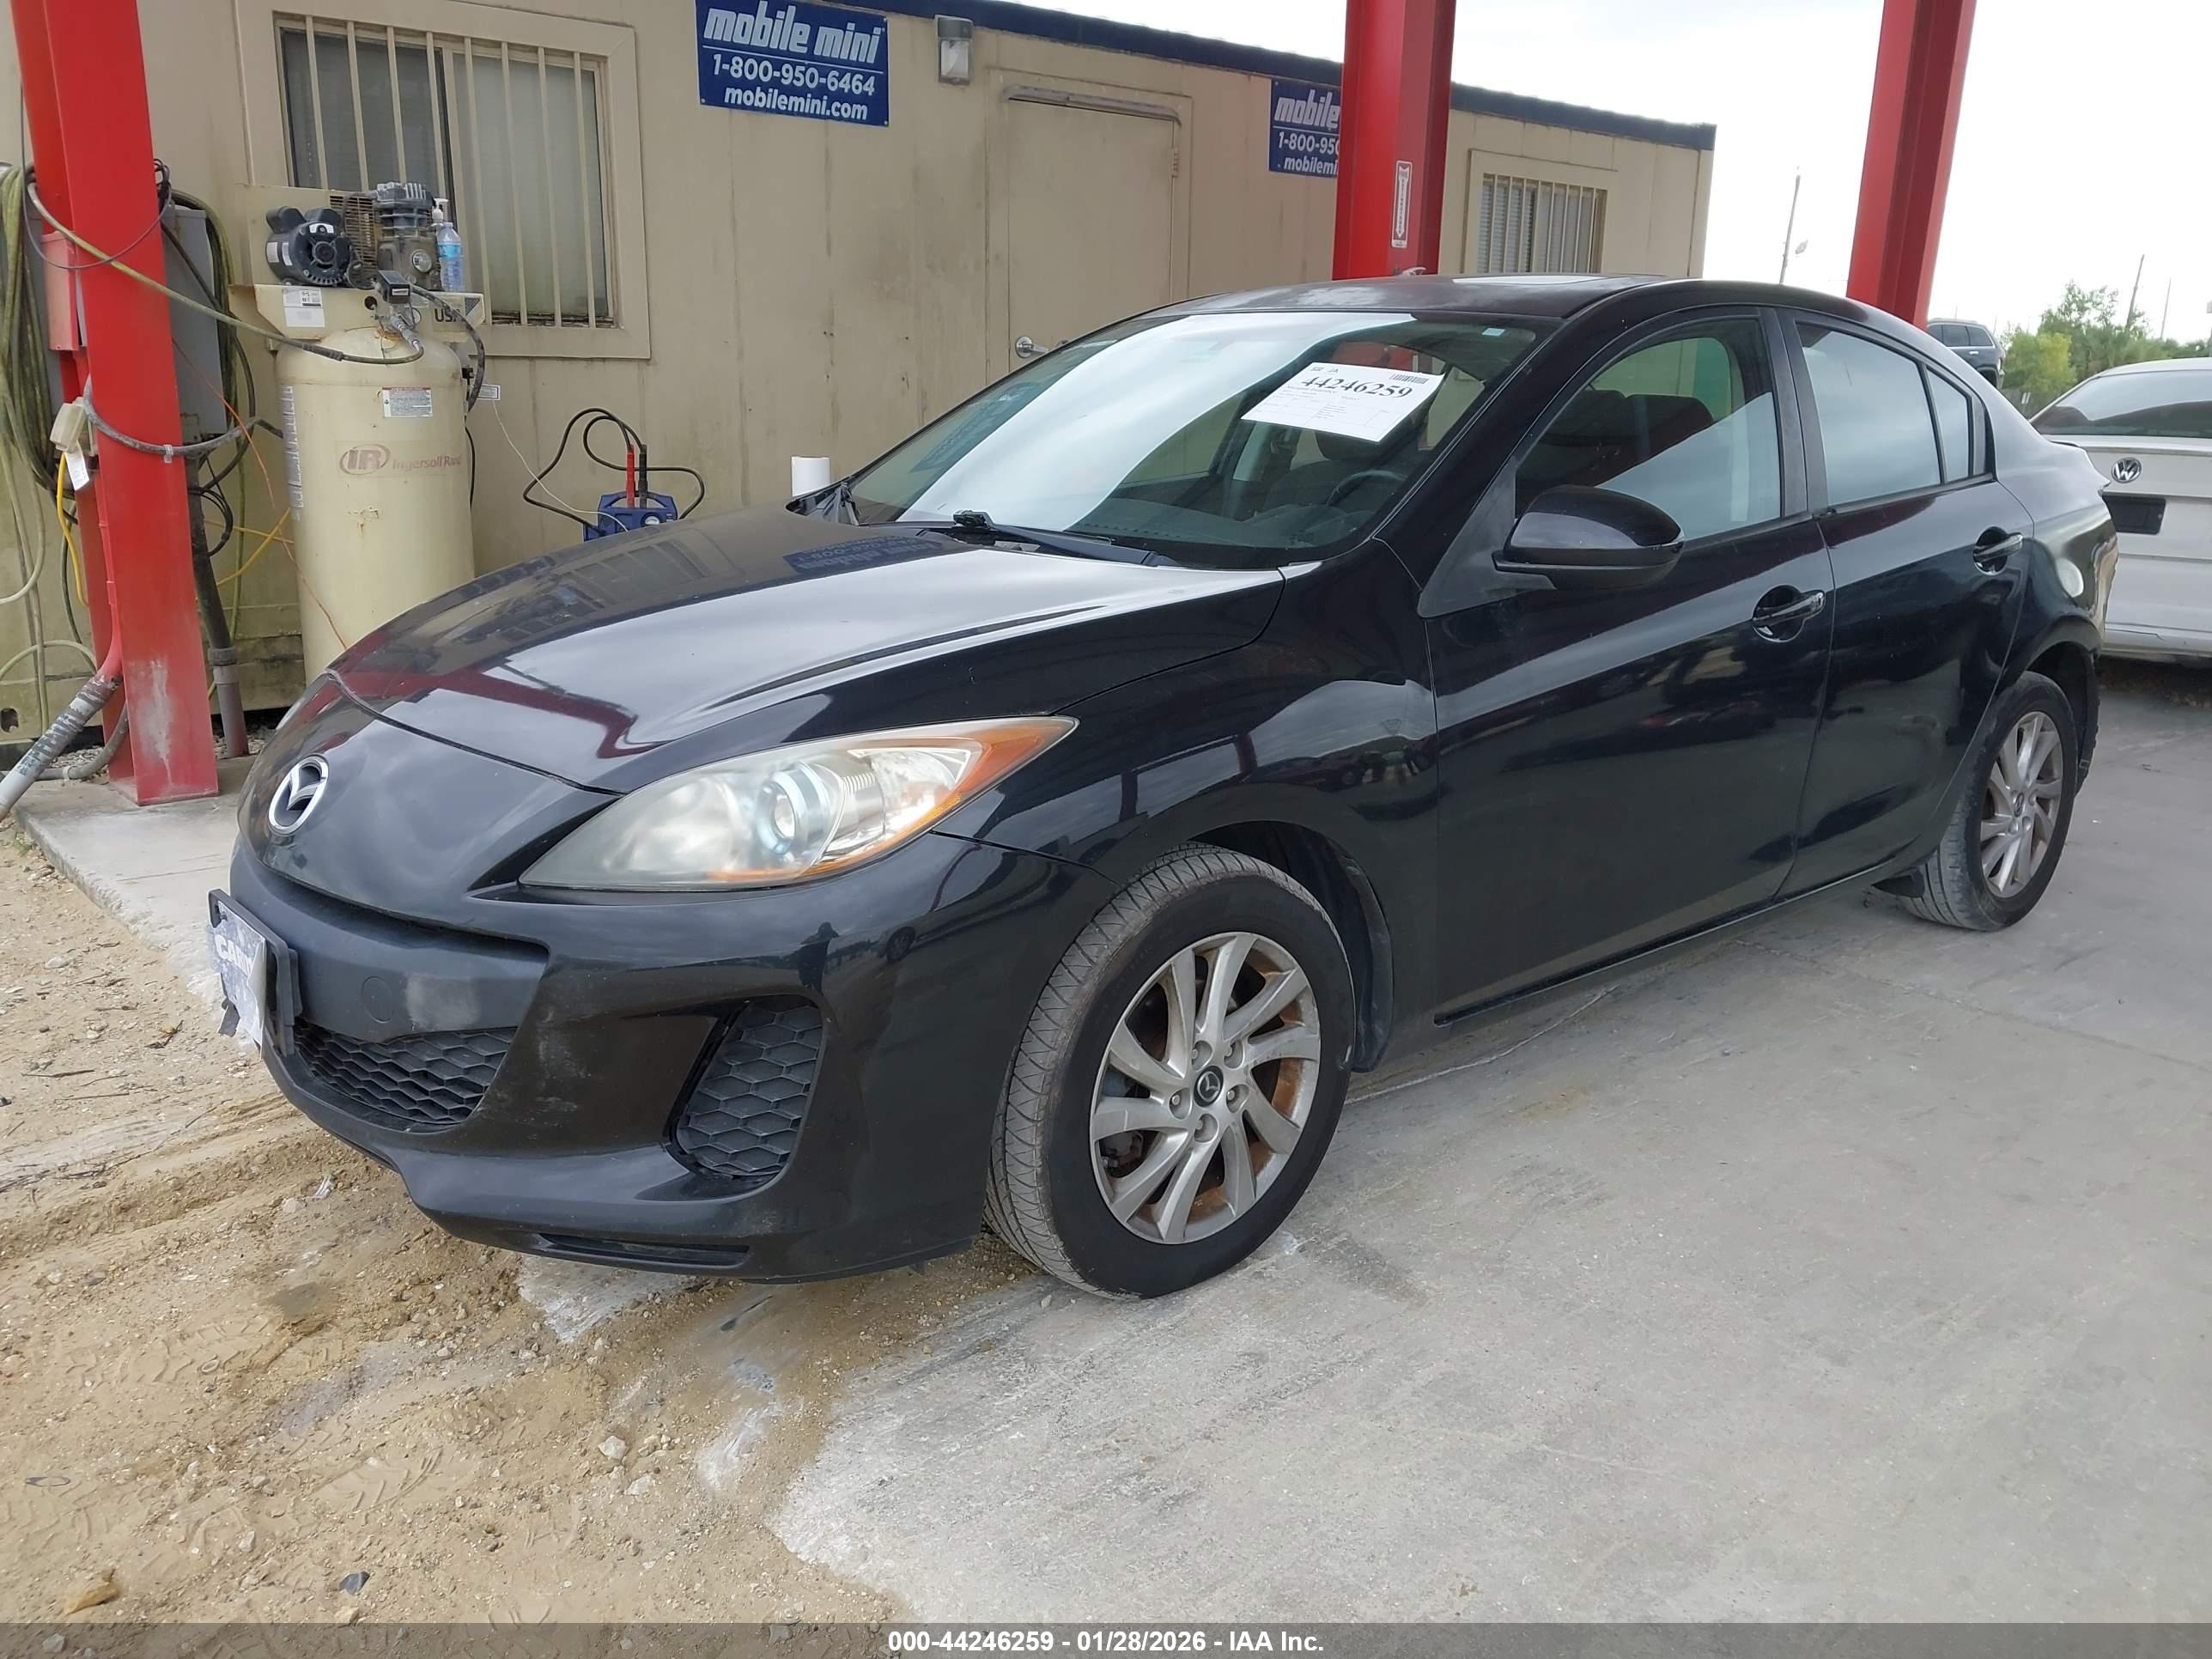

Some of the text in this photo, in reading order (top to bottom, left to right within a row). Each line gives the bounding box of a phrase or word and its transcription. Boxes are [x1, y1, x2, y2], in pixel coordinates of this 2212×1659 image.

[703, 0, 881, 64] mobile mini
[713, 53, 875, 96] 1-800-950-6464
[724, 87, 867, 120] mobilemini.com
[1274, 89, 1340, 129] mobile
[1300, 375, 1413, 398] 44246259
